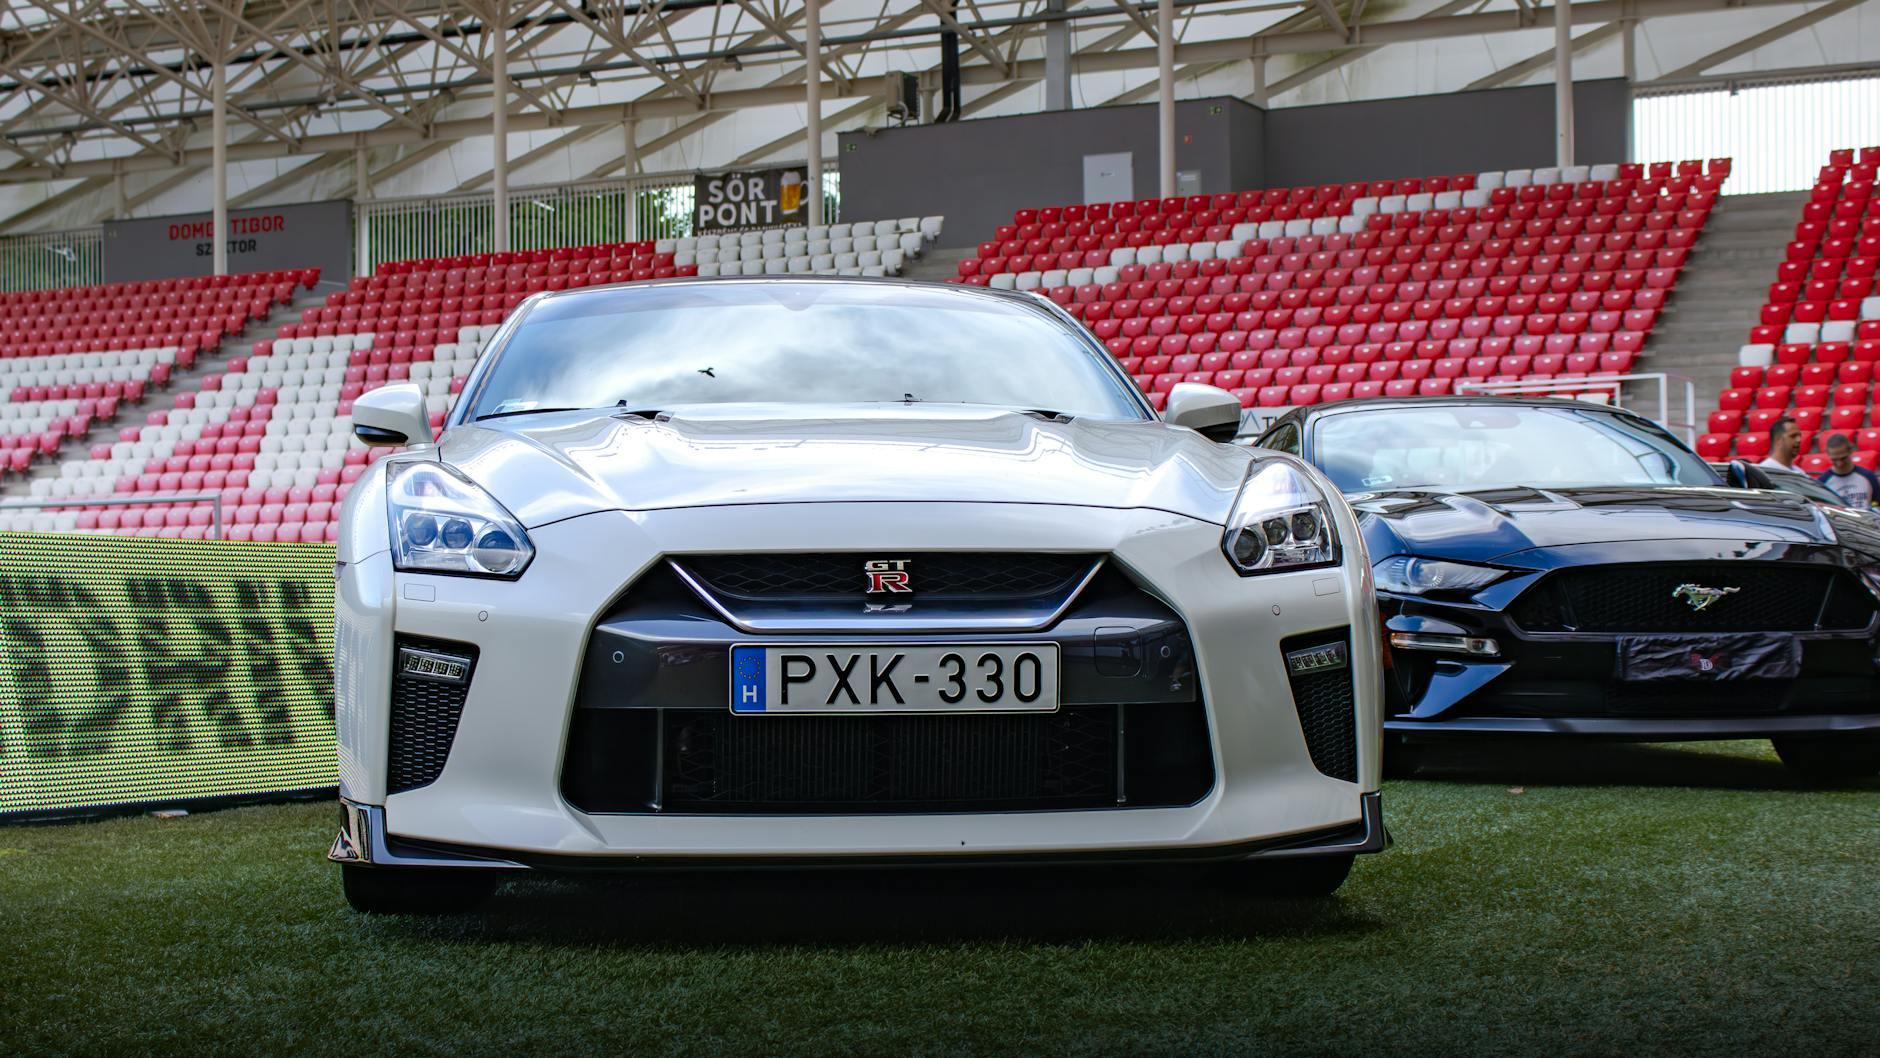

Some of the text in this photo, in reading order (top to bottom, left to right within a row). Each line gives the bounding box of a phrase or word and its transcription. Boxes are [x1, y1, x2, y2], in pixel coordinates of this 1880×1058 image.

[709, 174, 766, 204] SÖR
[699, 199, 777, 227] PONT
[231, 215, 284, 234] TIBOR
[865, 559, 912, 571] GT
[865, 571, 913, 593] R
[780, 652, 1042, 704] PXK-330
[742, 685, 757, 702] H
